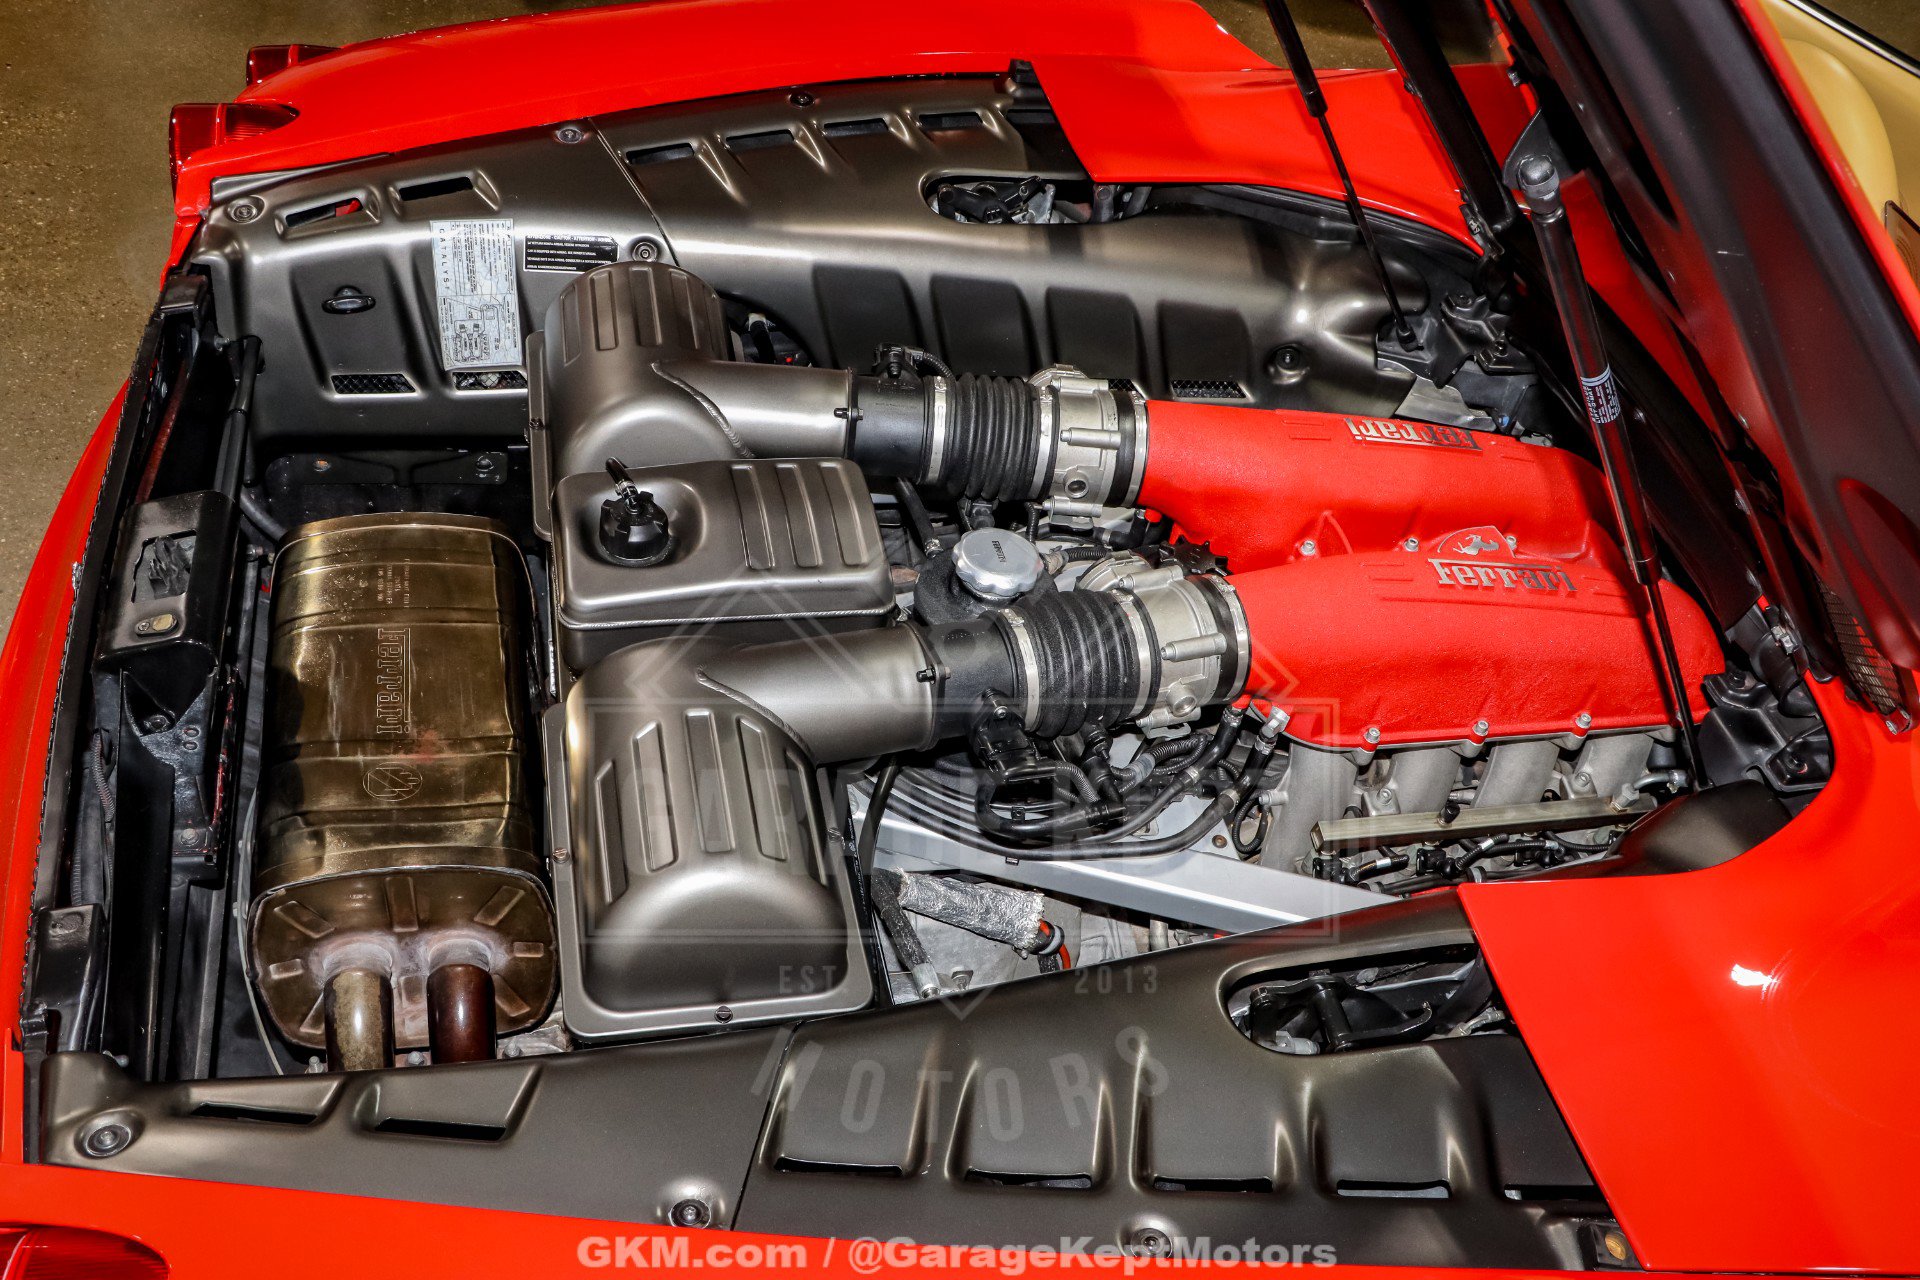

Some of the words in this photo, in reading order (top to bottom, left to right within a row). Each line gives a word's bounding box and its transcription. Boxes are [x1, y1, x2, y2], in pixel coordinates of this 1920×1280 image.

[439, 228, 450, 290] CATALYST
[1344, 418, 1482, 451] Ferrari
[1428, 558, 1577, 591] Ferrari
[376, 628, 411, 734] Ferrari
